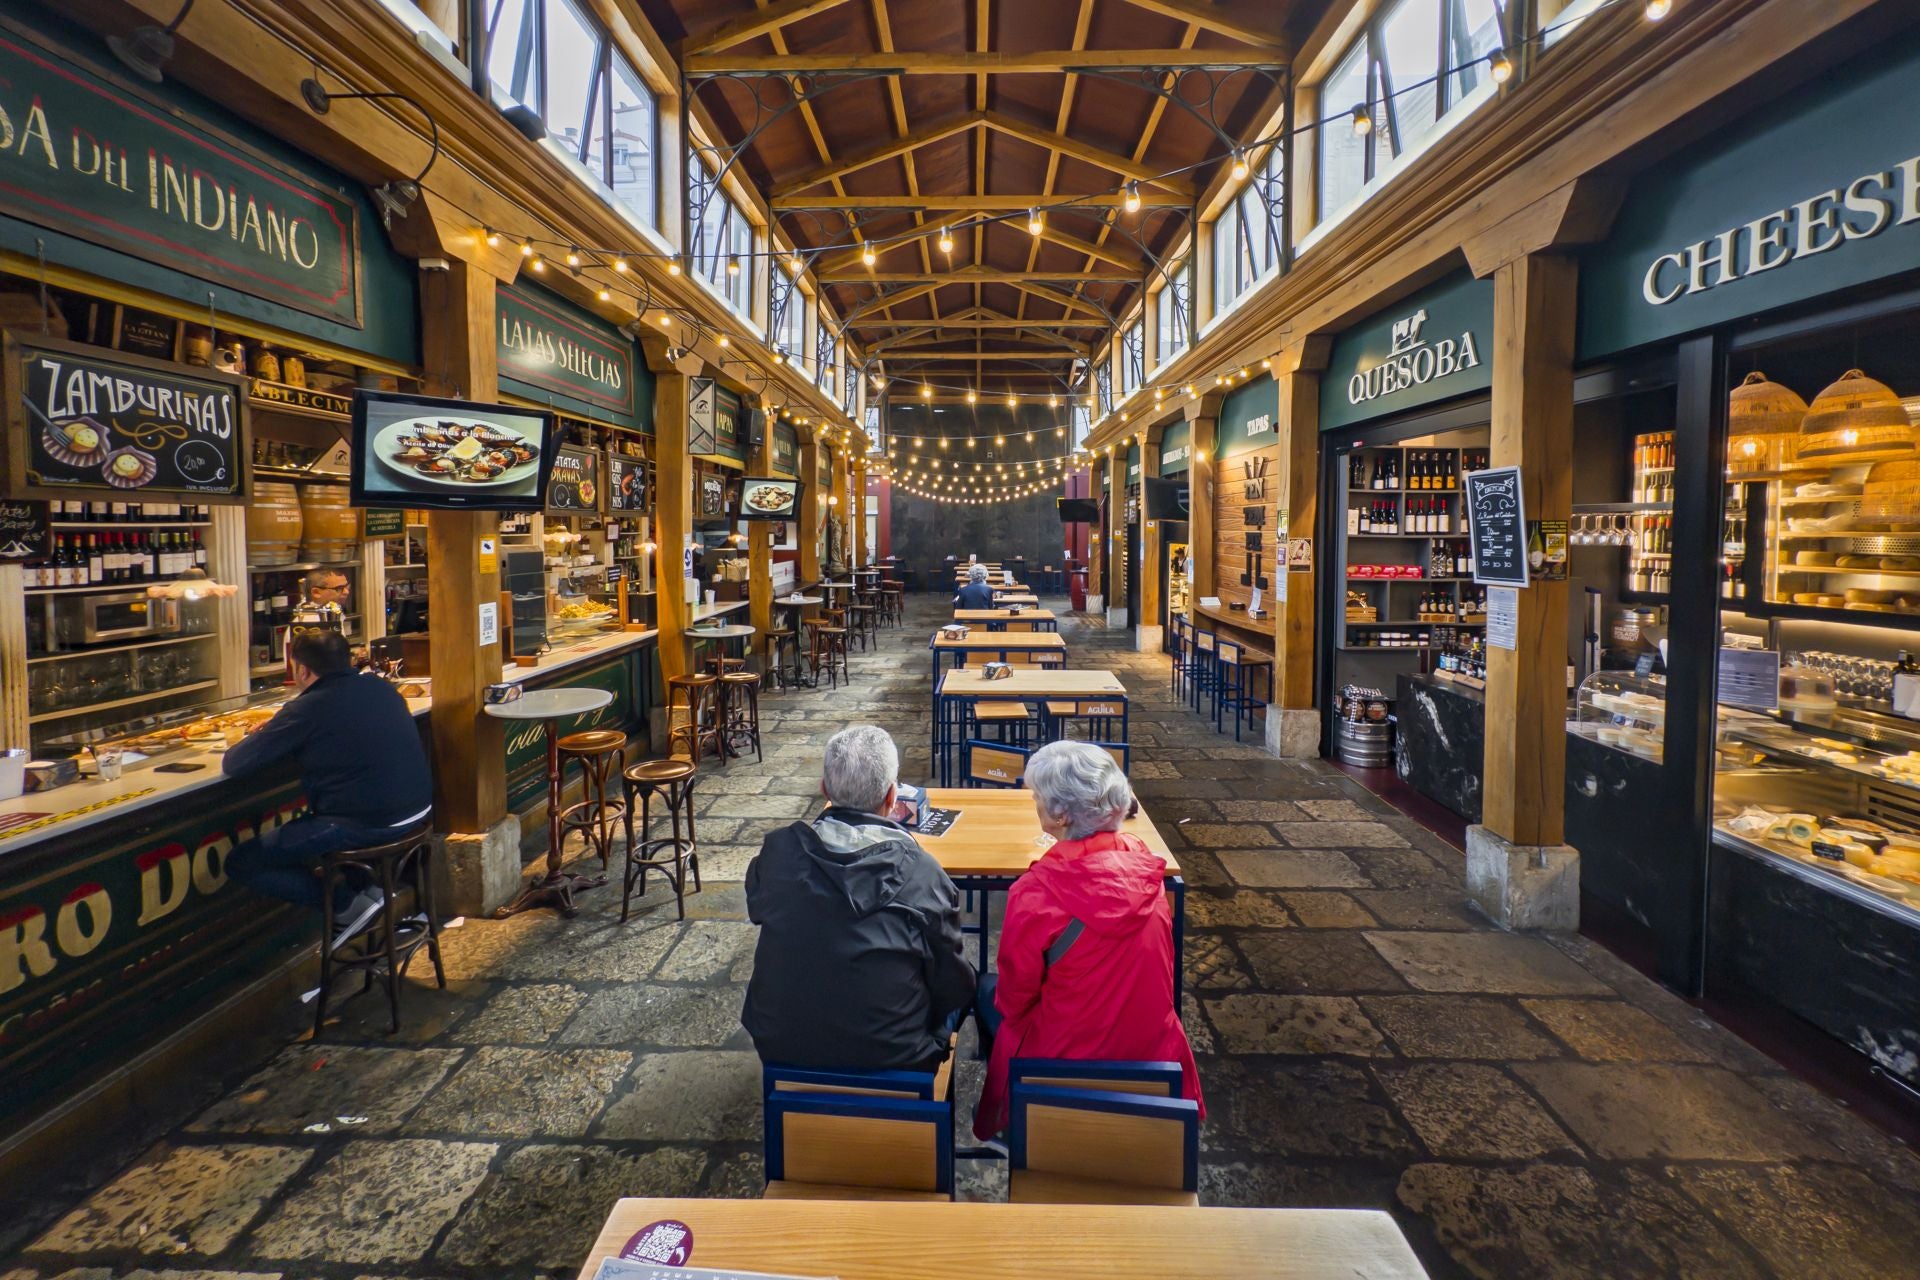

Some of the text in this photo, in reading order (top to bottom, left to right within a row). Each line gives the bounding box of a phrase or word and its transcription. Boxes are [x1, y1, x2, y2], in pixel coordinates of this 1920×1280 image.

[72, 126, 134, 193] DEL
[148, 146, 319, 270] INDIANO
[501, 310, 622, 389] LATAS SELECTAS
[1348, 331, 1481, 405] QUESOBA
[41, 359, 231, 440] ZAMBURIÑAS
[554, 455, 580, 470] ATATAS
